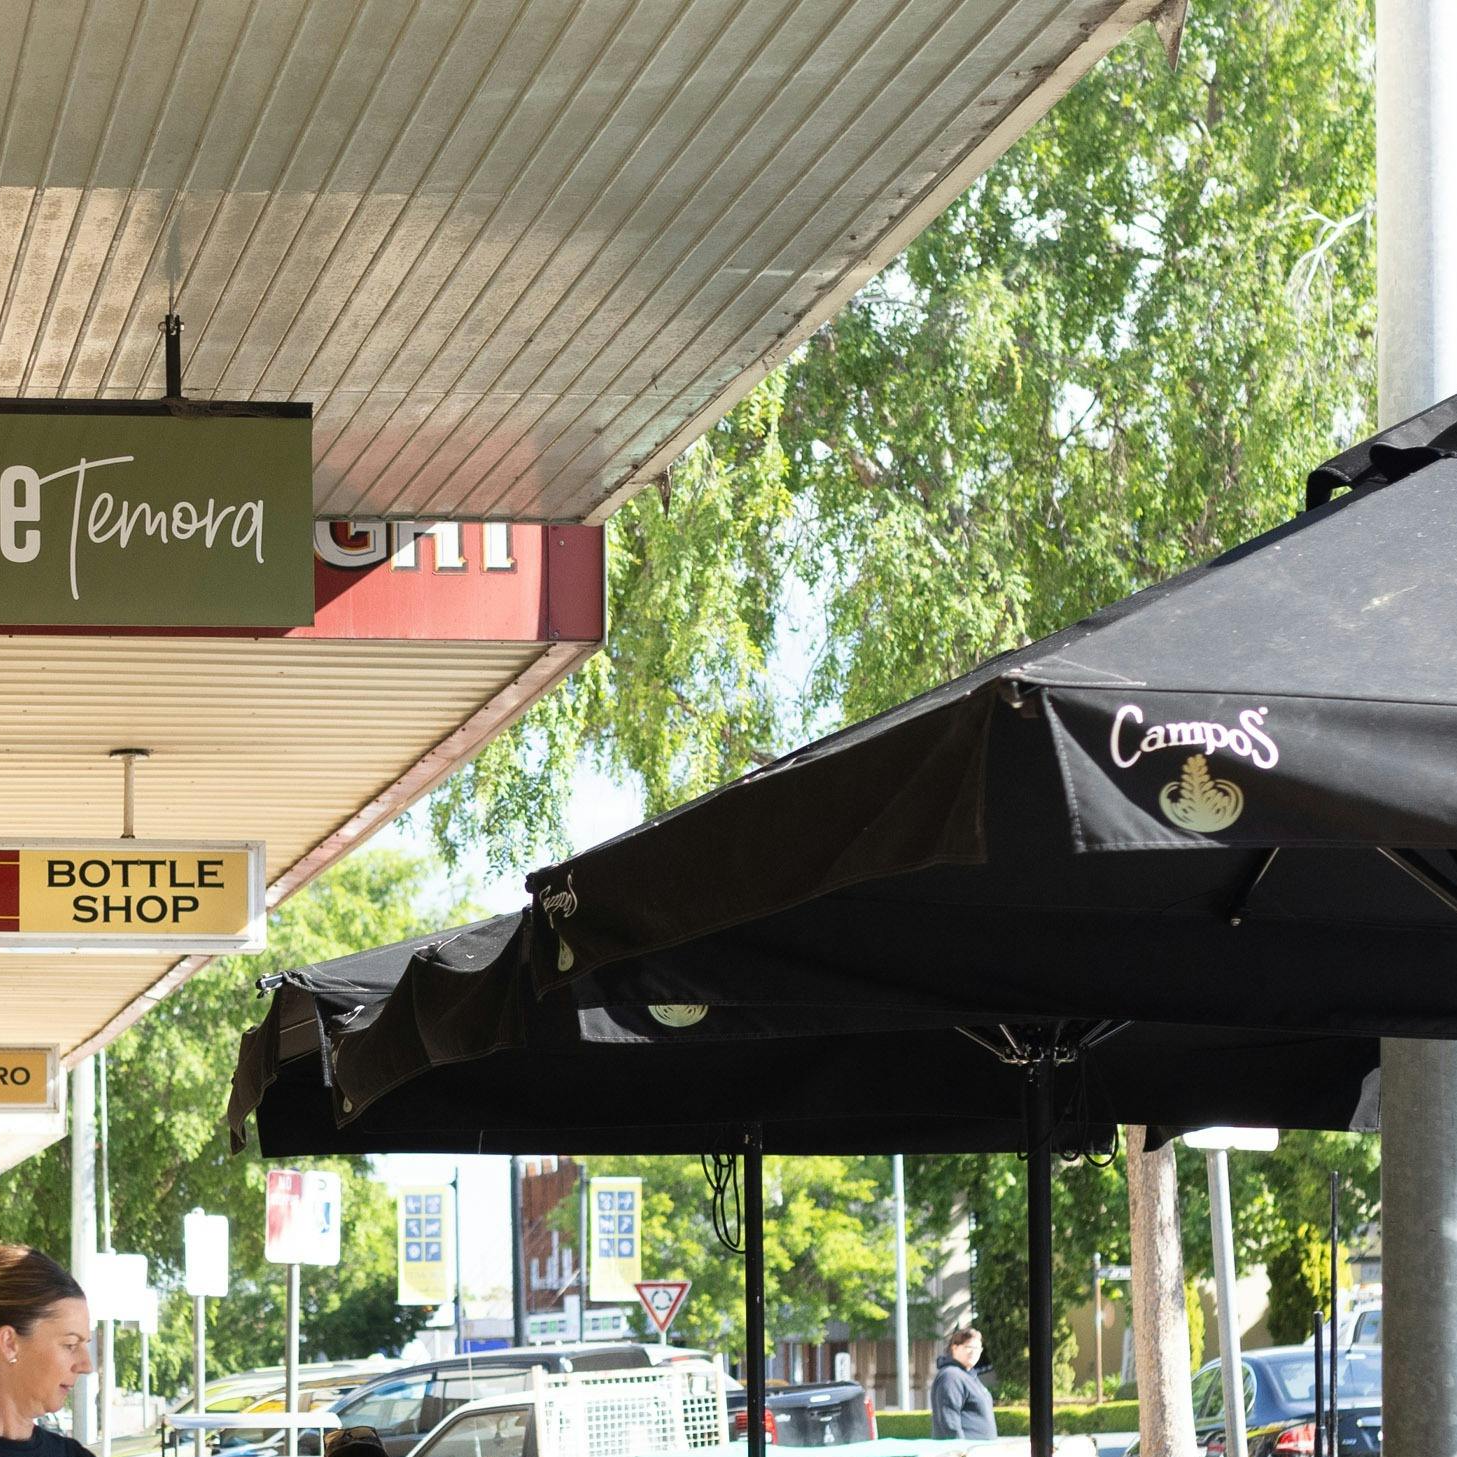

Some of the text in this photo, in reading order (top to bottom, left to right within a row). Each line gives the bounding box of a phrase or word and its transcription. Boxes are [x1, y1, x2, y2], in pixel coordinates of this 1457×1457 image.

[40, 455, 264, 600] Temora
[47, 859, 226, 889] BOTTLE
[72, 895, 200, 924] SHOP
